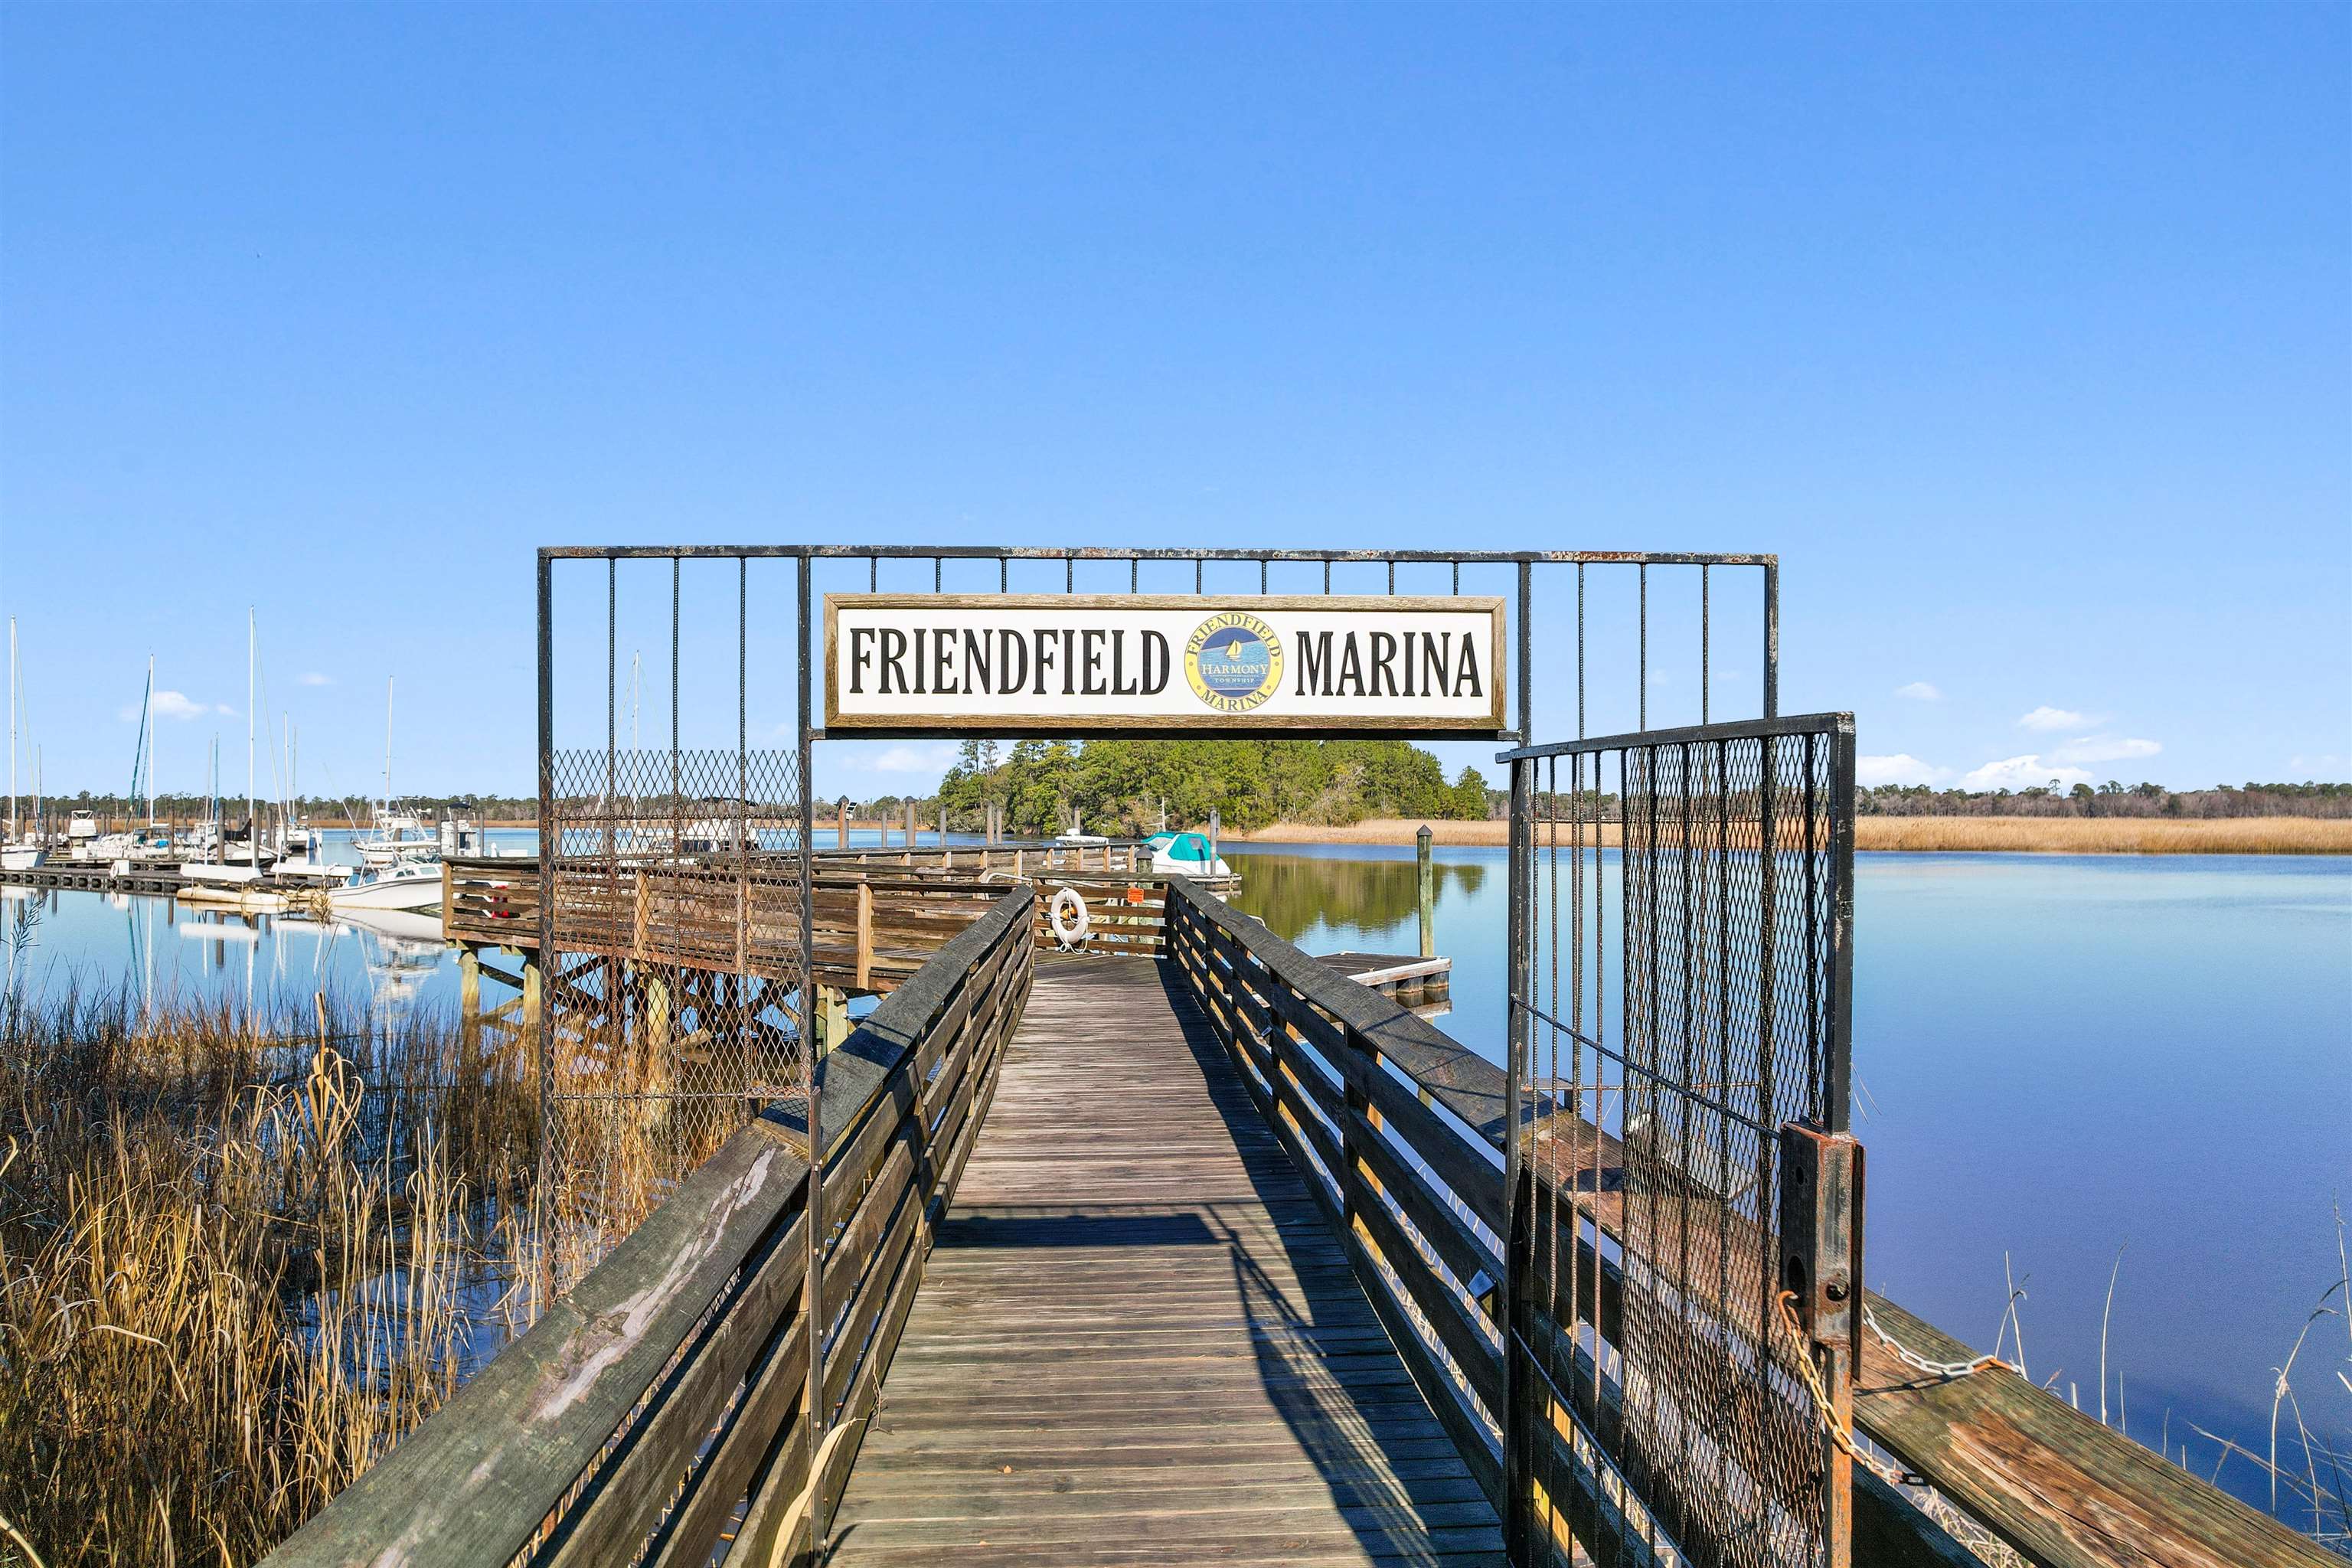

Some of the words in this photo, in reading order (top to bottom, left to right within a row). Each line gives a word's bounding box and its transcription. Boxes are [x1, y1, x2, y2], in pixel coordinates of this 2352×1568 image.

[1187, 614, 1281, 657] FRIENDFIELD
[850, 629, 1169, 694] FRIENDFIELD
[1295, 632, 1482, 697] MARINA
[1202, 664, 1268, 675] HARMONY
[1201, 689, 1269, 710] MARINA
